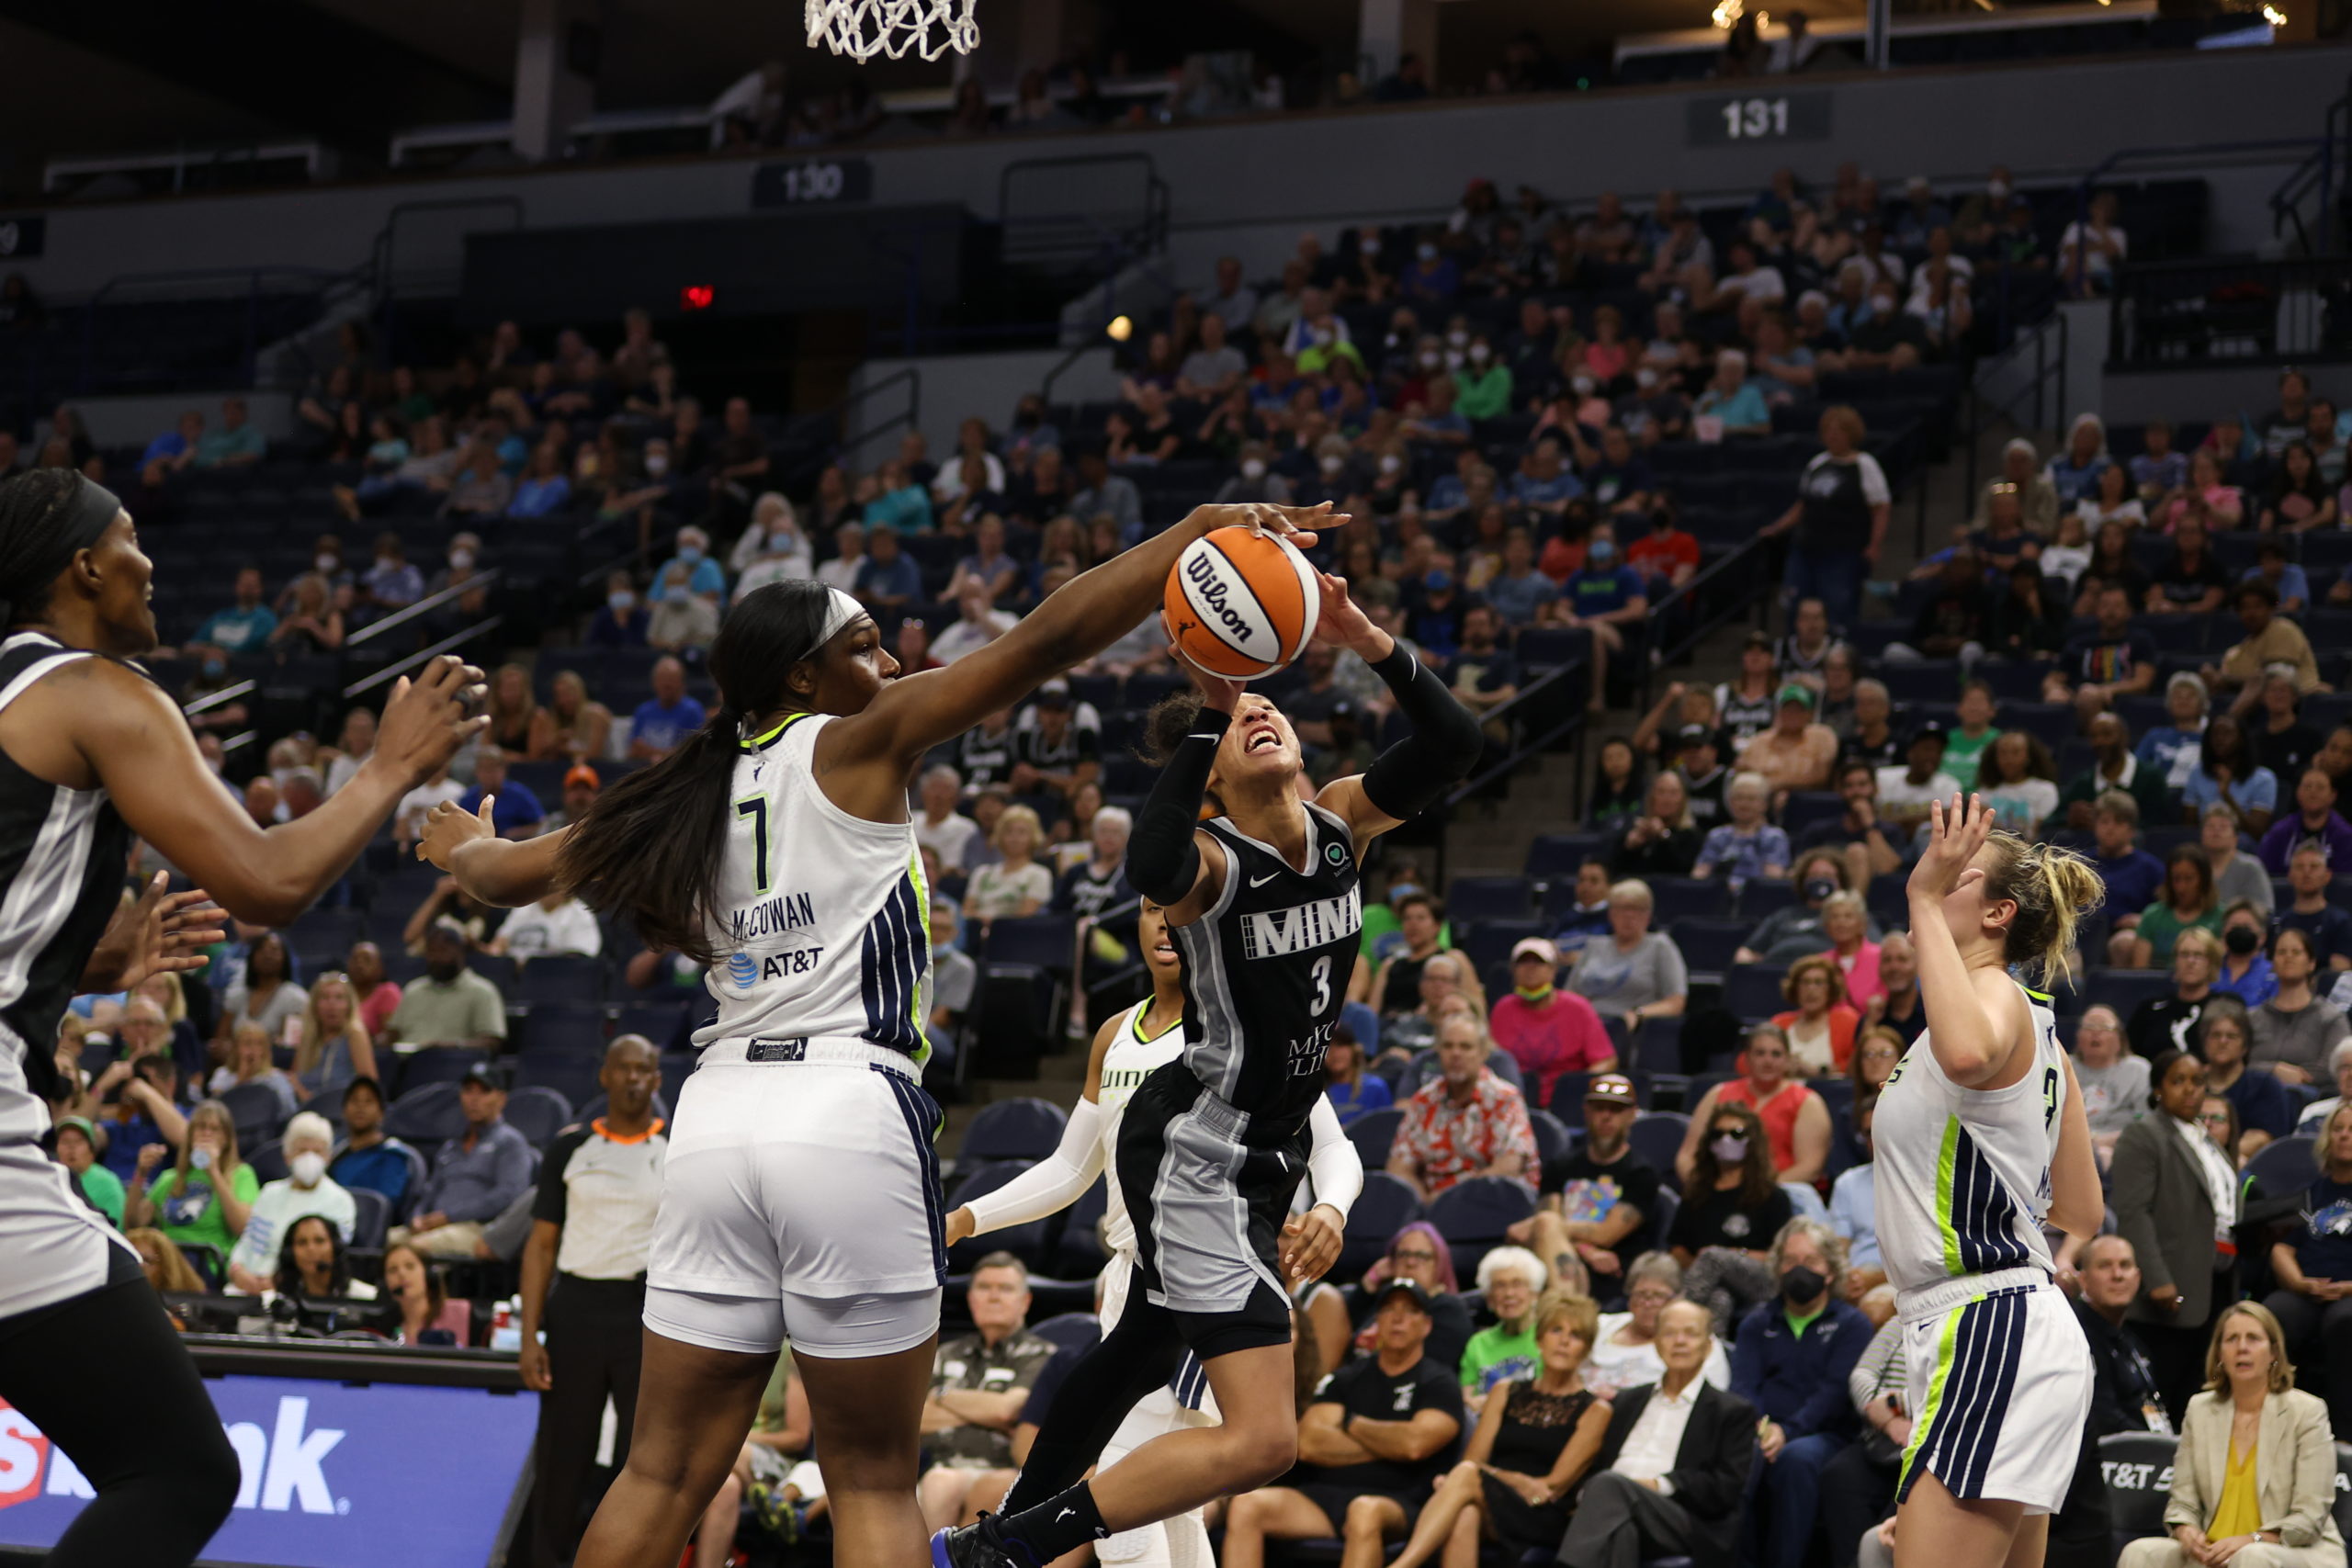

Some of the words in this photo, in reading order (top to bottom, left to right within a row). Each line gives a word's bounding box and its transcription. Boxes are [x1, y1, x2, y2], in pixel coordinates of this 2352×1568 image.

[1721, 98, 1788, 138] 131
[783, 164, 843, 200] 130
[1187, 551, 1253, 644] Wilson
[734, 792, 771, 896] 7
[733, 892, 816, 942] McCOWAN
[763, 947, 824, 980] AT&T
[1310, 955, 1332, 1017] 3
